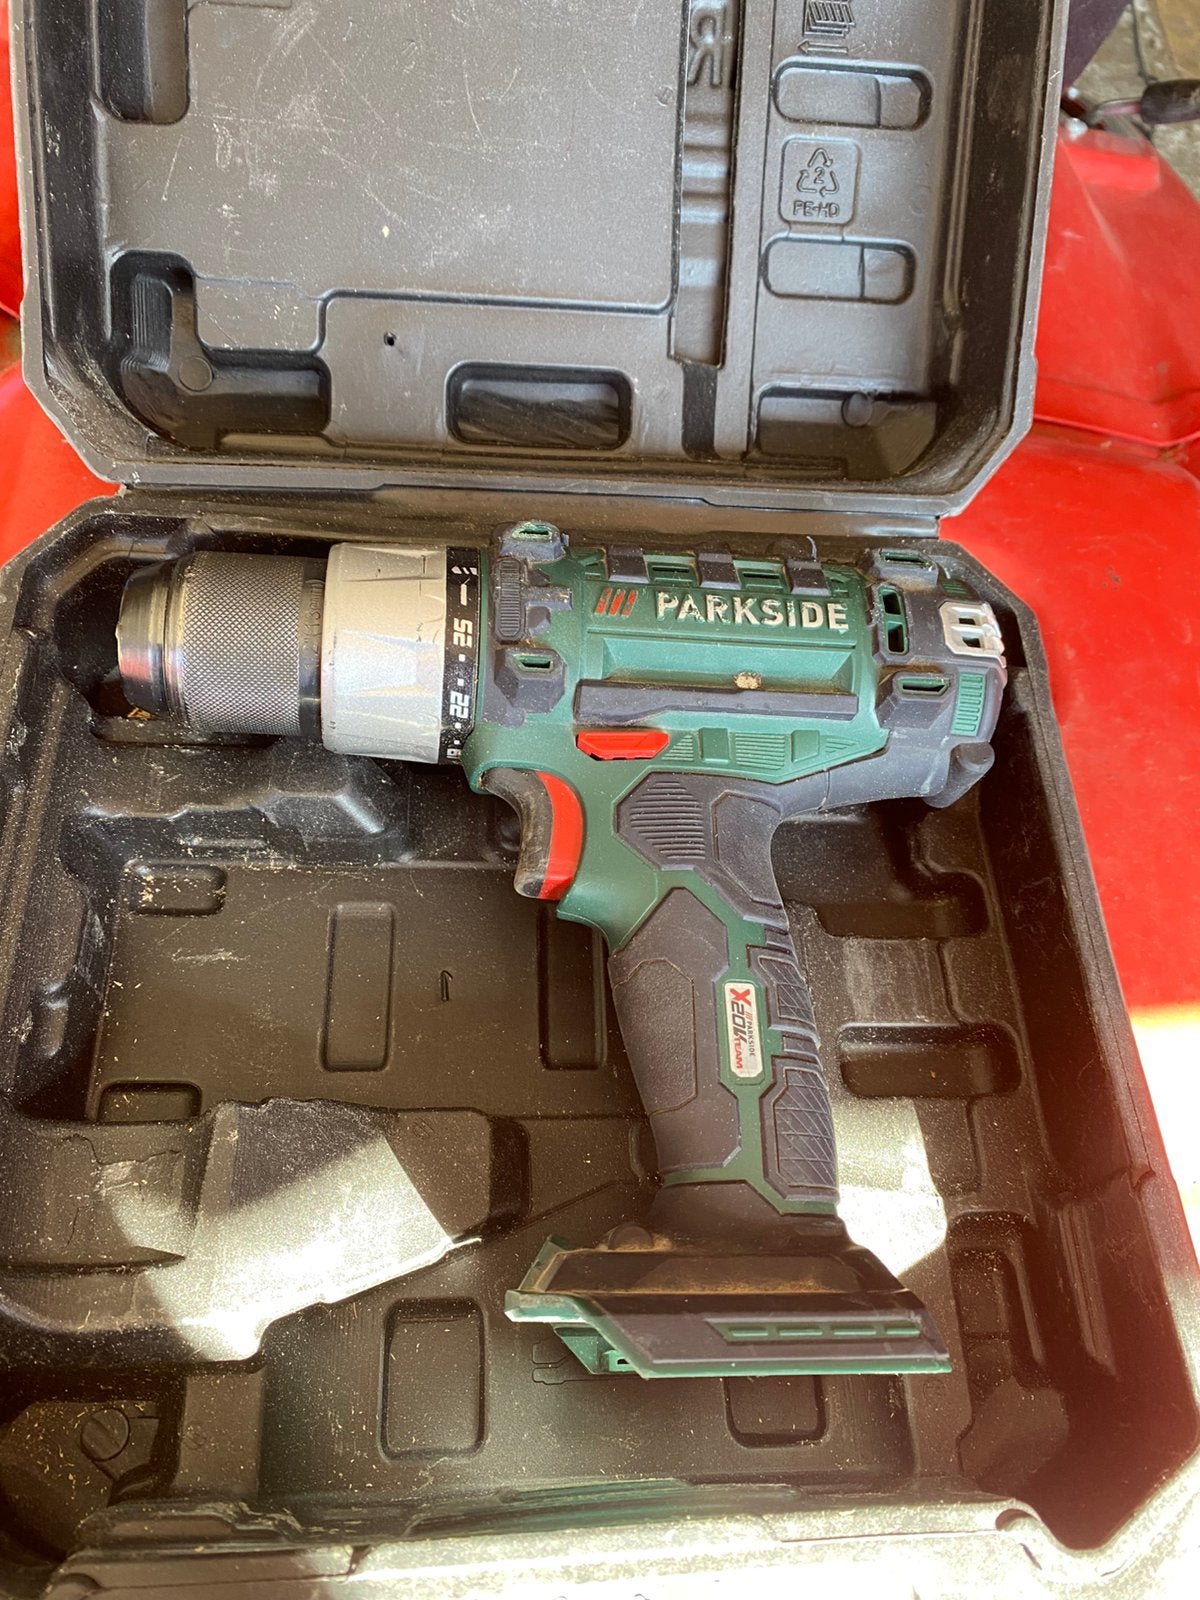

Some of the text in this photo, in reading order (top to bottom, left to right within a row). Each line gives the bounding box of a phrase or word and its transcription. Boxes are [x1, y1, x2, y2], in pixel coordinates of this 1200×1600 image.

[813, 166, 826, 185] 2
[792, 199, 841, 218] PE-HD
[655, 591, 849, 631] PARKSIDE
[452, 617, 473, 648] 25
[449, 690, 471, 719] 22
[746, 1020, 756, 1057] PARKSIDE
